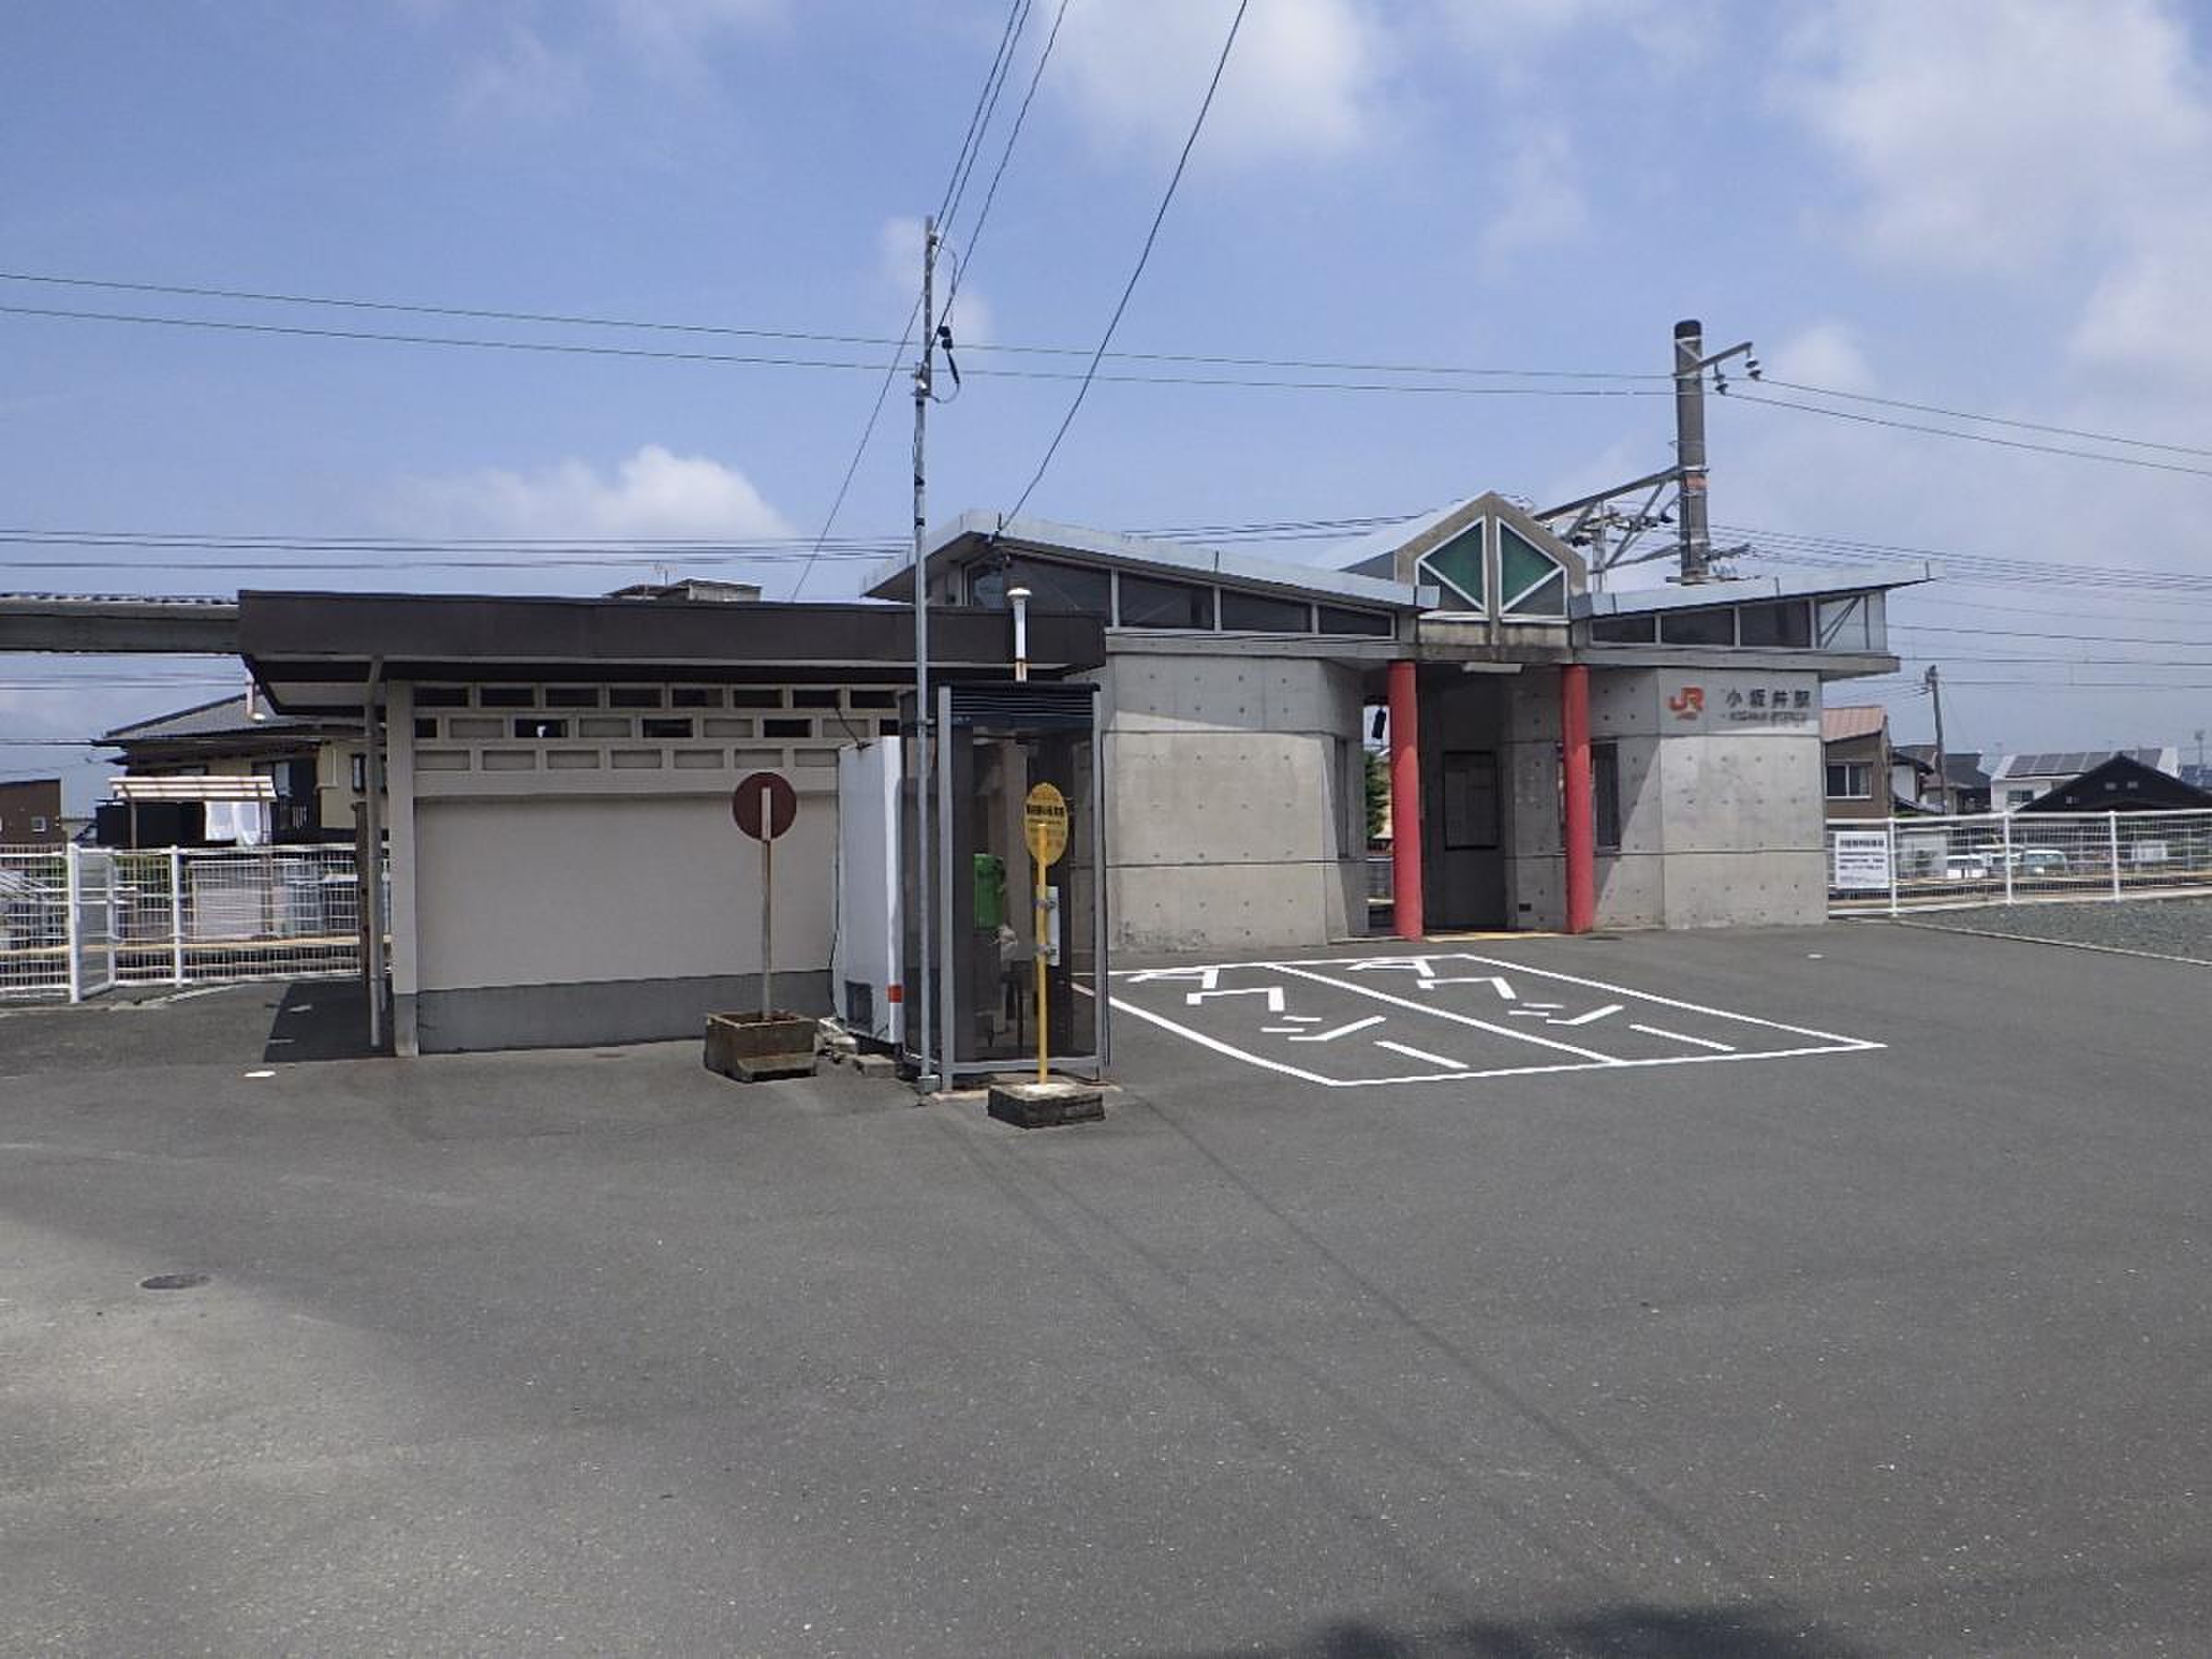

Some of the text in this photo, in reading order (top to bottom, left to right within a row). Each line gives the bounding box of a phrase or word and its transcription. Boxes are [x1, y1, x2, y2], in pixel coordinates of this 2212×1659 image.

[1668, 687, 1704, 712] JR
[1126, 967, 1470, 1069] タクシー
[1346, 959, 1735, 1052] タクシー
